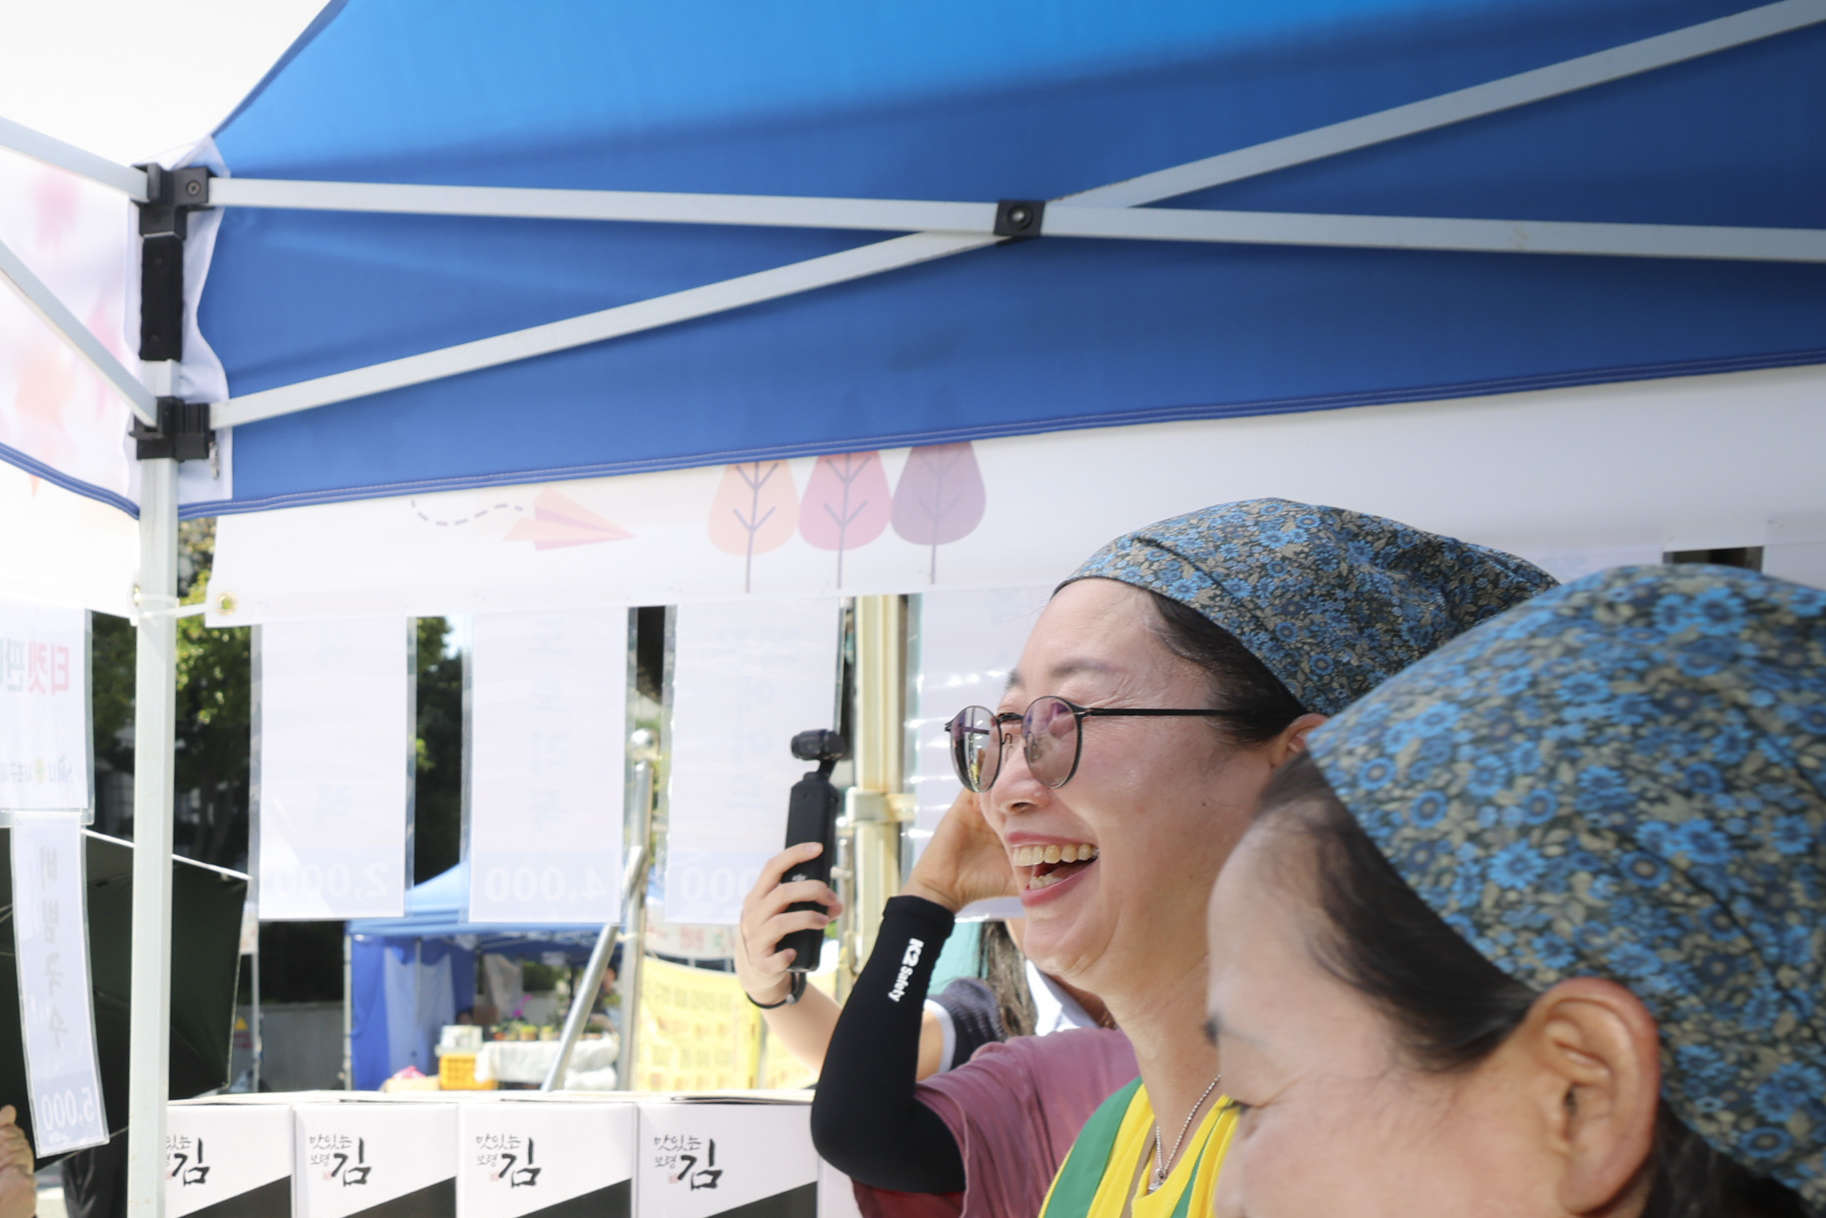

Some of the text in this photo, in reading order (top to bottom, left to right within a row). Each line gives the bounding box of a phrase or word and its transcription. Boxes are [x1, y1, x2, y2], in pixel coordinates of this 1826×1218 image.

[888, 938, 925, 1002] K2 Safety
[166, 1134, 192, 1150] 있는
[171, 1137, 211, 1187] 김
[309, 1133, 353, 1150] 맛있는
[331, 1137, 372, 1187] 김
[475, 1133, 522, 1150] 맛있는
[498, 1137, 542, 1189] 김
[653, 1134, 702, 1151] 맛있는
[677, 1138, 724, 1191] 김
